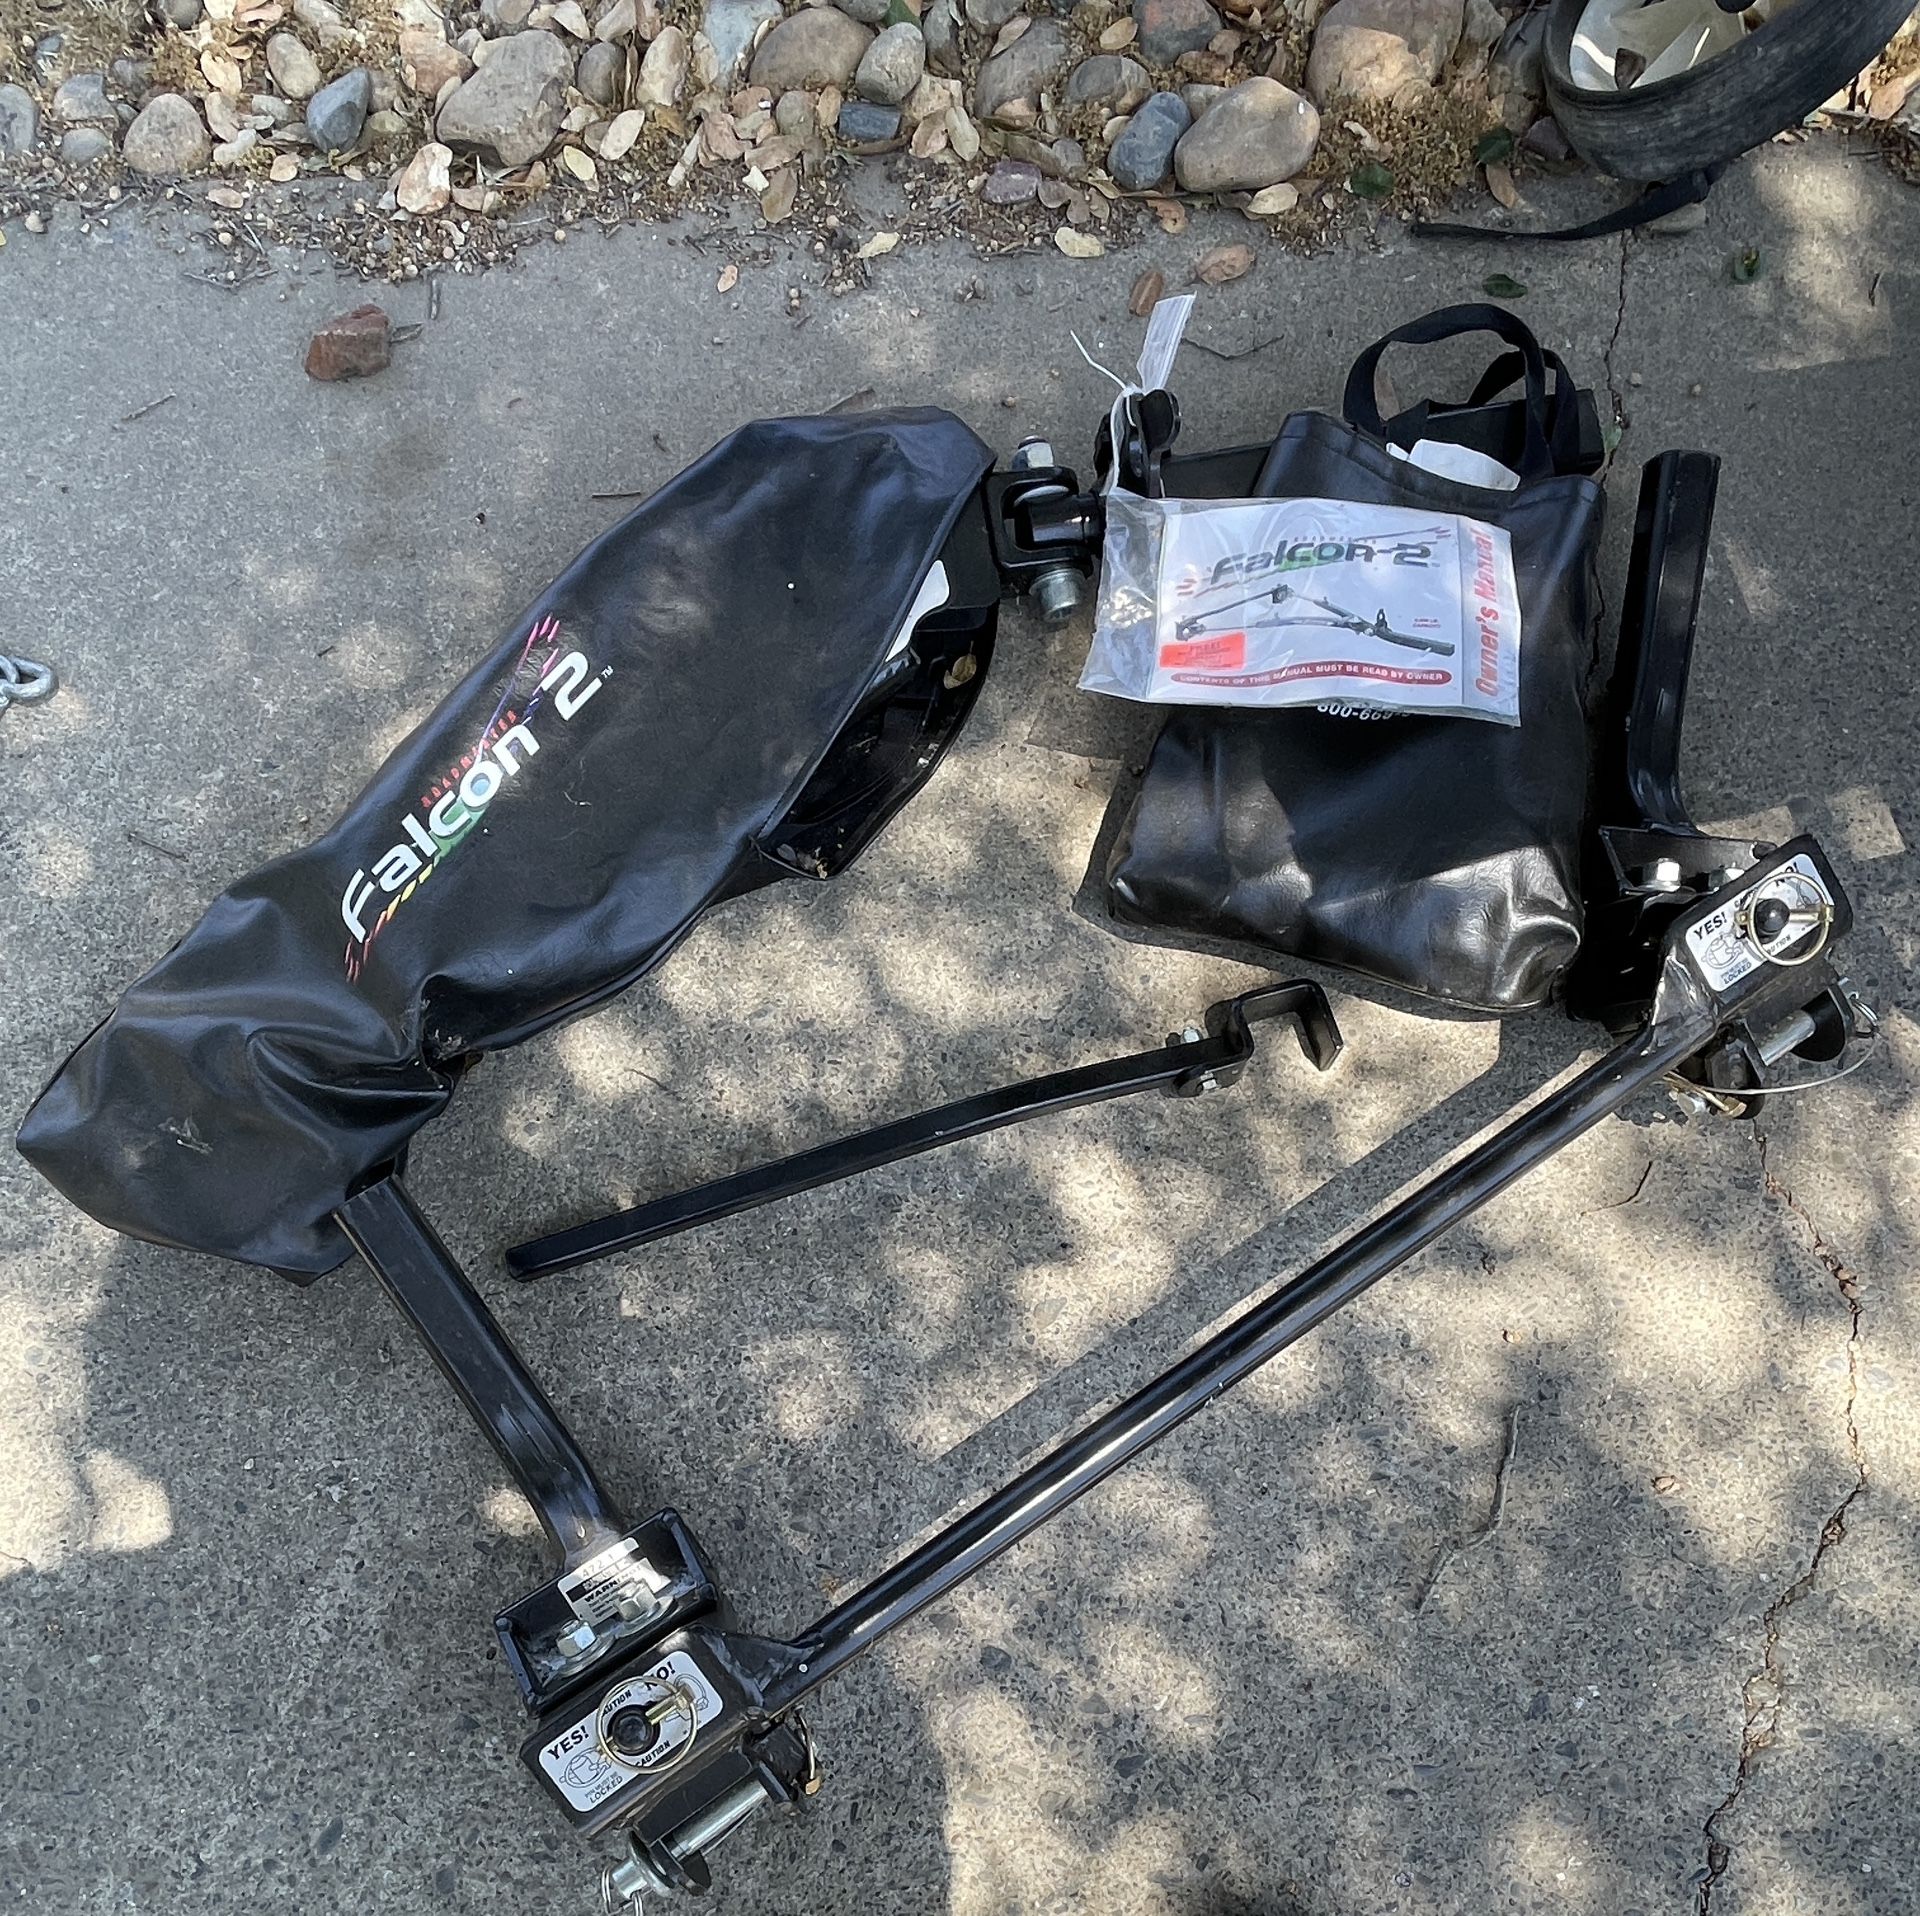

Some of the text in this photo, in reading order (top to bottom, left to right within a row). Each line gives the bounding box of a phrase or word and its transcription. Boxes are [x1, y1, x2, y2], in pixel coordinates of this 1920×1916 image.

[1470, 528, 1498, 697] Owner's Manual
[1315, 664, 1343, 673] MUST
[1346, 664, 1359, 673] BE
[1362, 666, 1388, 676] READ
[1390, 669, 1404, 679] BY
[1406, 672, 1443, 681] OWNER
[1694, 911, 1728, 941] YES!
[1723, 962, 1752, 985] LOCKED
[602, 1689, 633, 1718] AUTION
[548, 1725, 589, 1761] YES!
[590, 1775, 623, 1804] LOCKED
